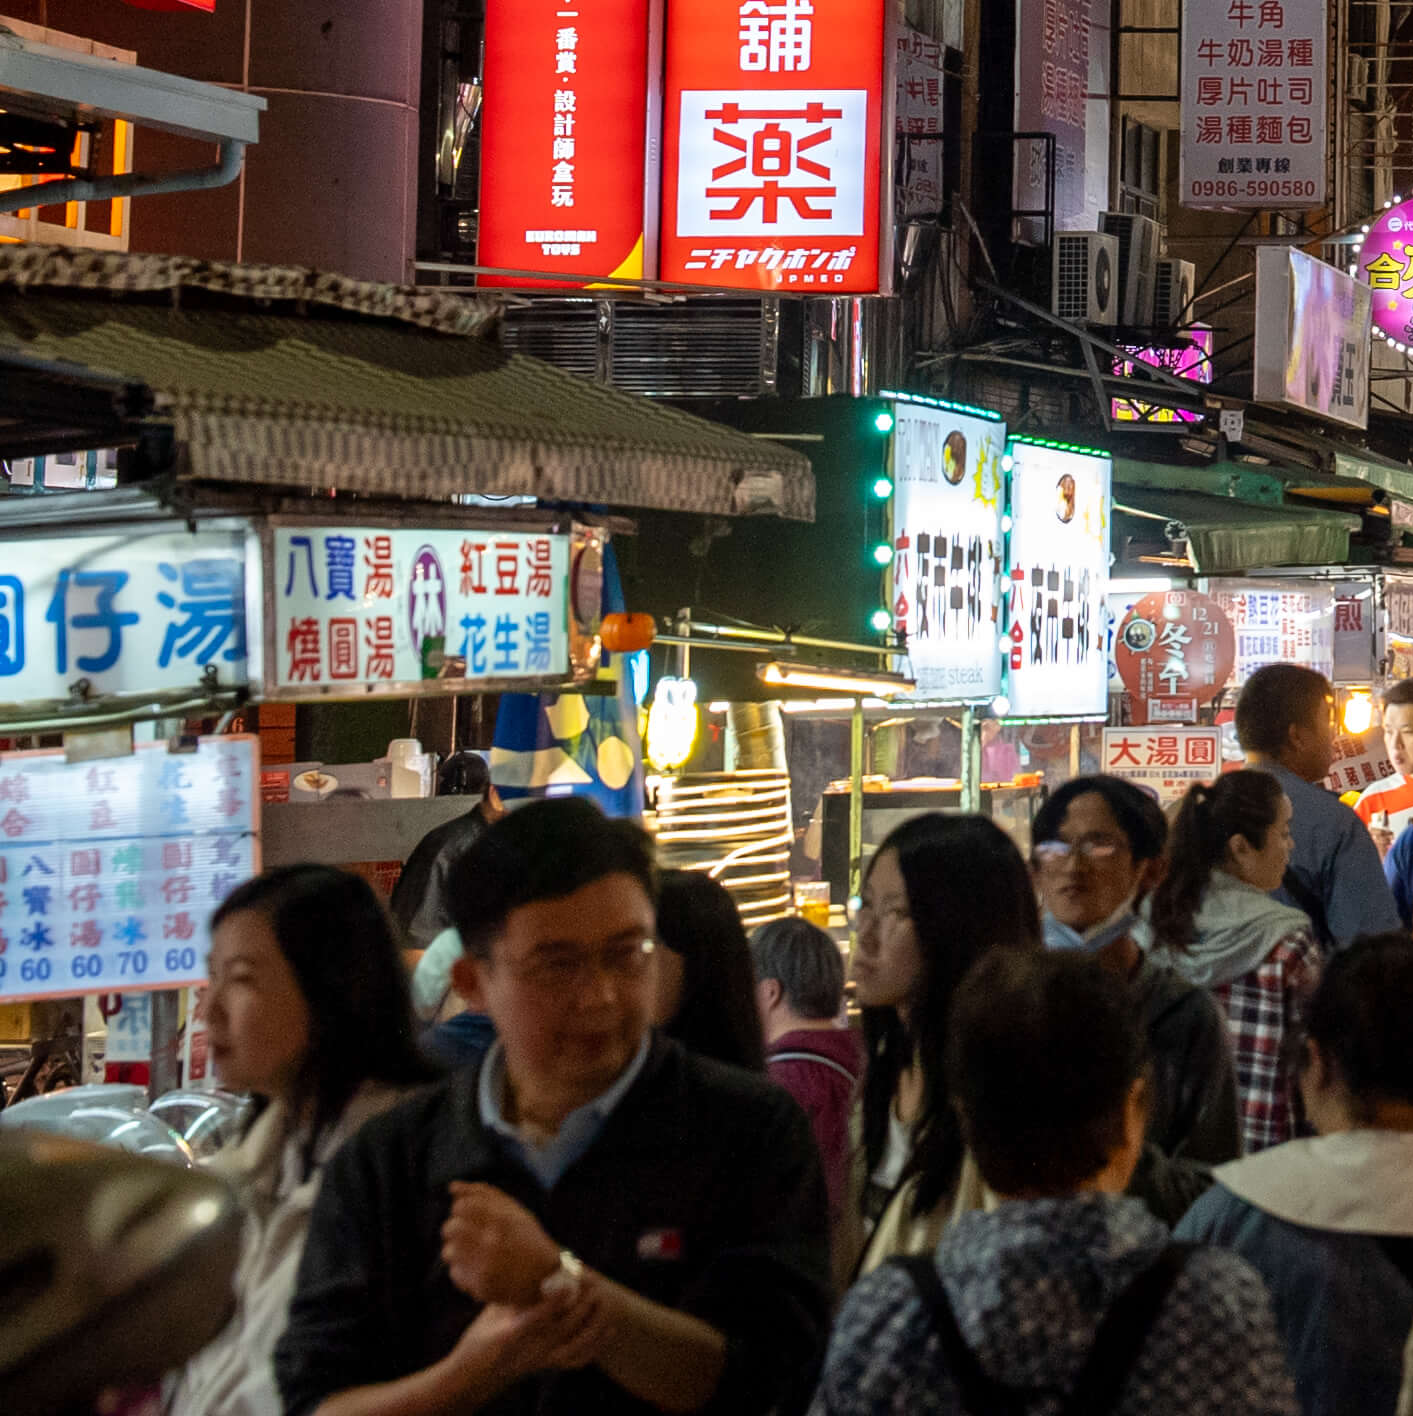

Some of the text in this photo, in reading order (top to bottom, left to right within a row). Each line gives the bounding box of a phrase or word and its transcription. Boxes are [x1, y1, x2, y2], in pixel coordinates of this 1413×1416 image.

[1227, 0, 1283, 29] 牛角
[1197, 38, 1313, 67] 牛奶湯種
[1196, 77, 1312, 106] 厚片吐司
[1192, 180, 1315, 197] 0986-590580
[284, 535, 395, 601] 八寶湯
[459, 539, 552, 597] 紅豆湯
[286, 616, 395, 681] 燒圓湯
[458, 612, 550, 673] 花生湯
[1110, 737, 1215, 766] 大湯圓
[21, 957, 51, 981] 60
[72, 954, 103, 978] 60
[117, 950, 148, 975] 70
[165, 947, 196, 971] 60
